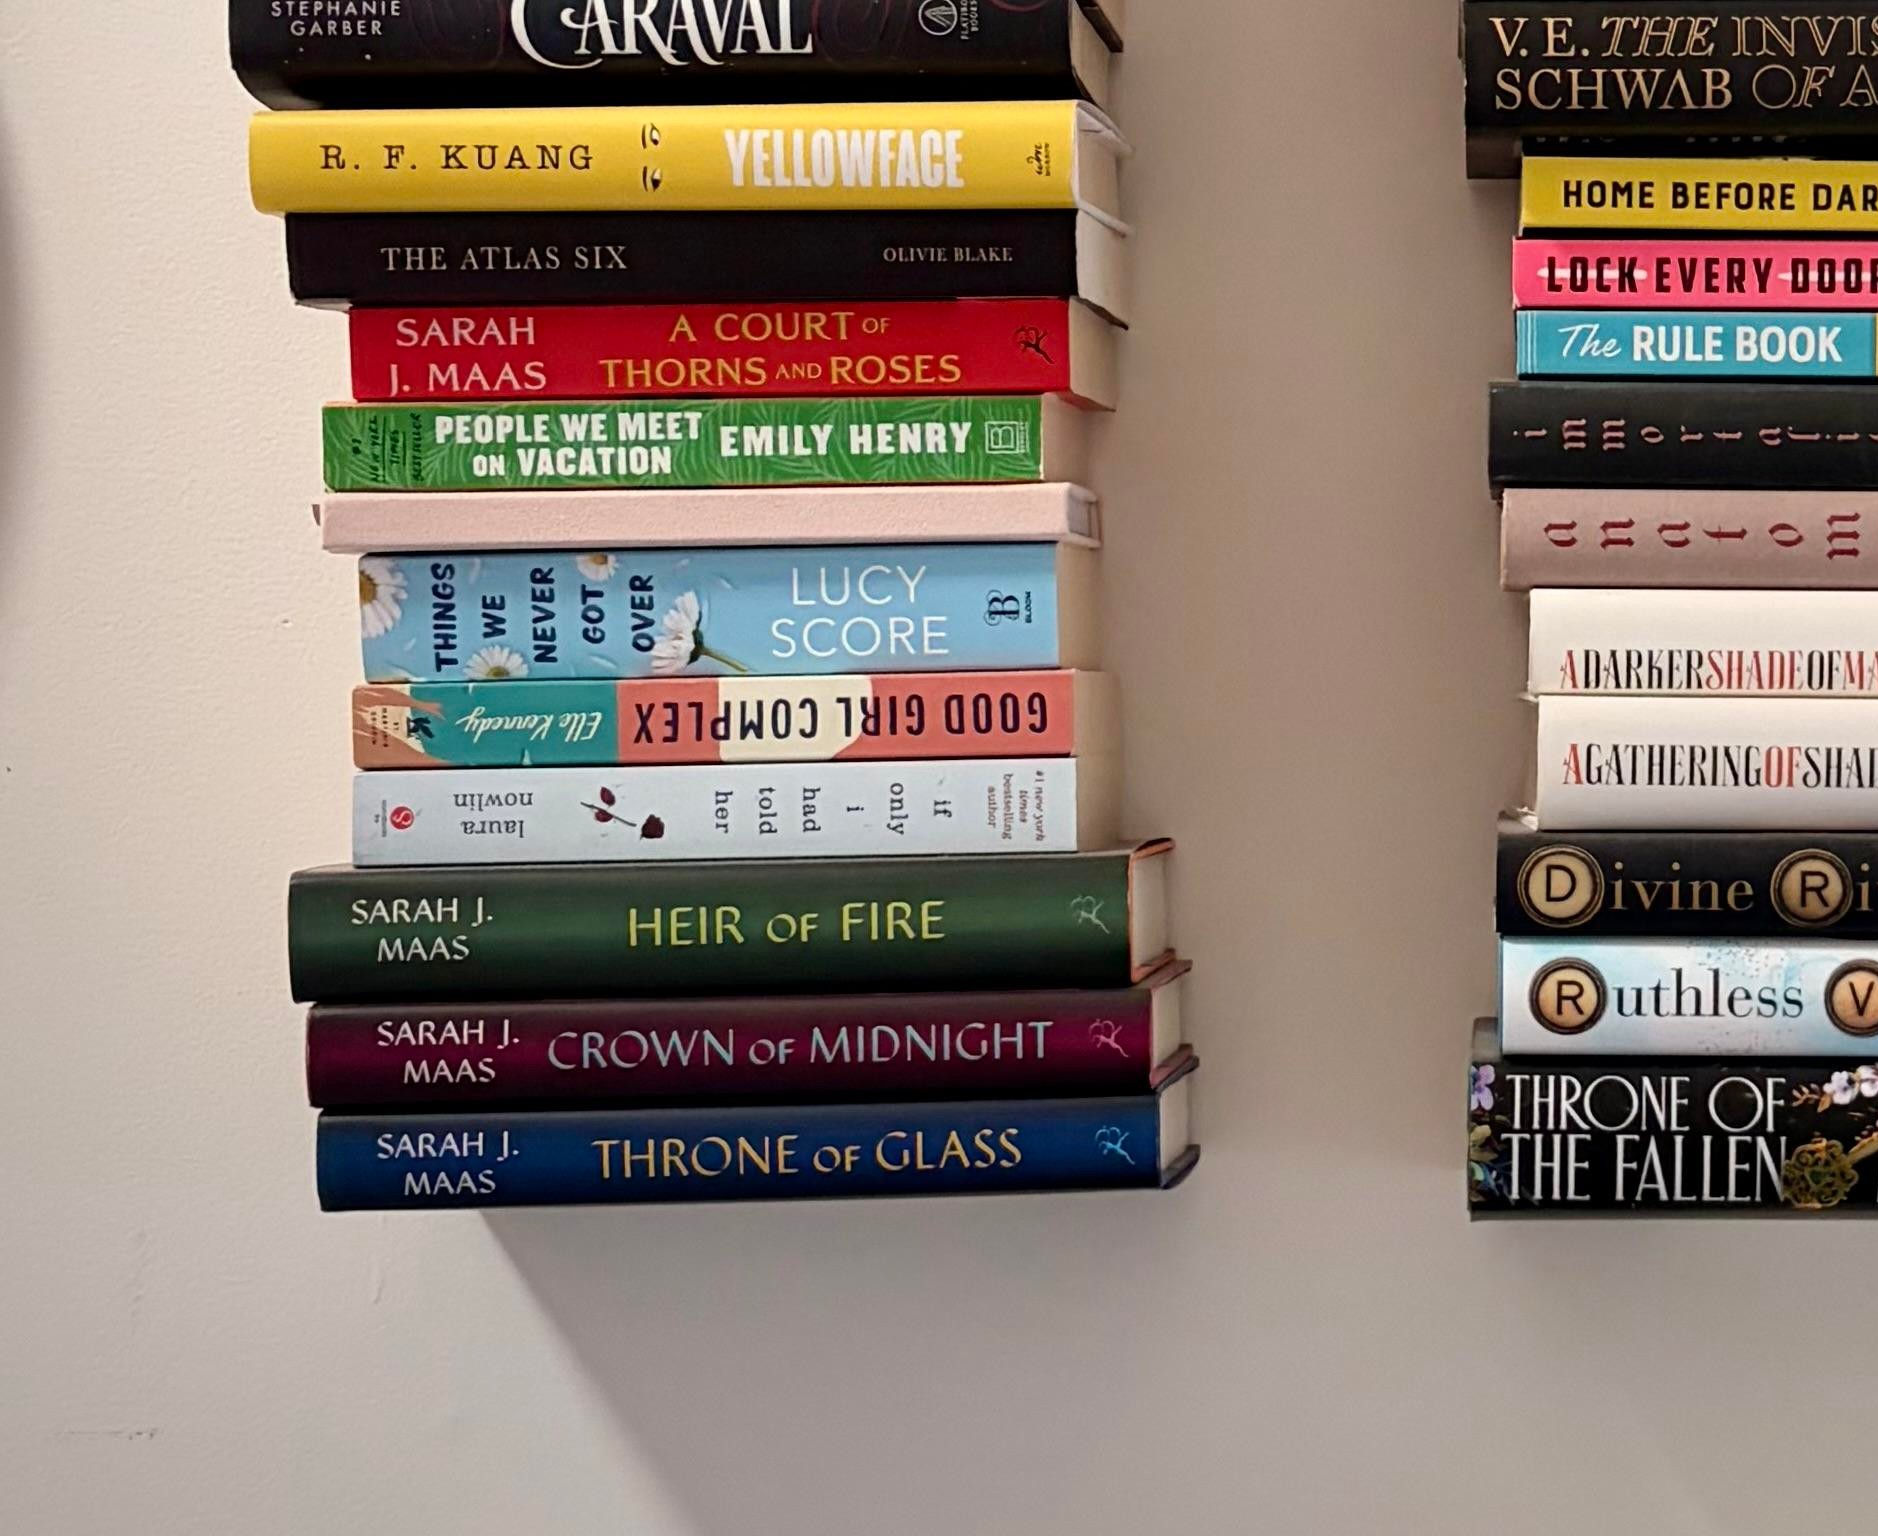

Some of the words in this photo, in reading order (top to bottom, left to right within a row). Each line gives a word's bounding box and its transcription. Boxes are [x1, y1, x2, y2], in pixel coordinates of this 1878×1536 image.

[271, 0, 401, 18] STEPHANIE
[290, 18, 382, 36] GARBER
[321, 144, 362, 171] R.
[385, 144, 417, 171] F.
[441, 143, 593, 171] KUANG
[725, 129, 964, 188] YELLOWFACE
[883, 246, 947, 262] OLIVIE
[953, 246, 1013, 262] BLAKE
[792, 566, 926, 606] LUCY
[431, 563, 457, 671] THINGS
[482, 593, 506, 638] WE
[530, 567, 556, 663] NEVER
[581, 583, 605, 645] GOT
[631, 574, 655, 653] OVER
[771, 616, 948, 657] SCORE
[633, 697, 819, 743] COMPLEX
[837, 694, 924, 738] GIRL
[944, 692, 1048, 733] GOOD
